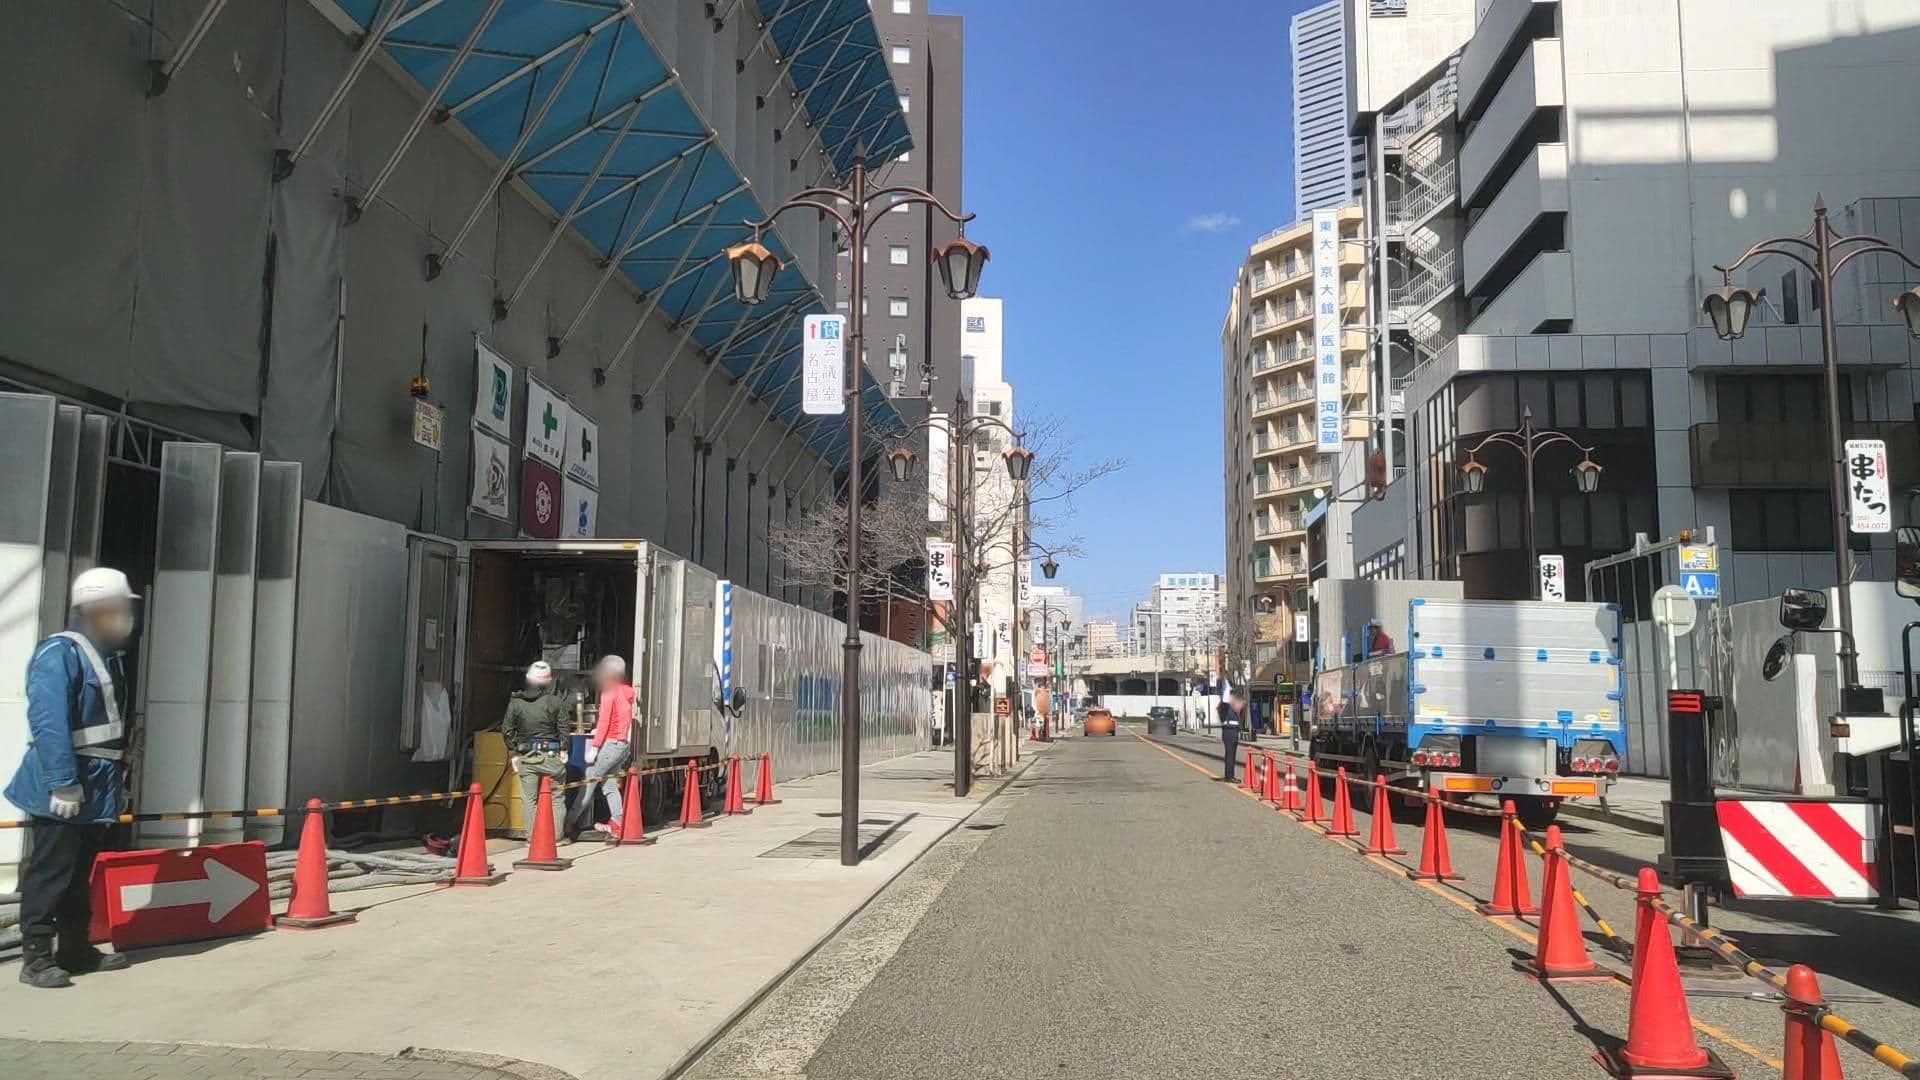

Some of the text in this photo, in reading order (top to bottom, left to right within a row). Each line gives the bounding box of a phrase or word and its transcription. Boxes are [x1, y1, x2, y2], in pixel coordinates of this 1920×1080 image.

[807, 353, 818, 401] 名古屋
[821, 320, 840, 401] 貸会議室
[1321, 401, 1339, 443] 河合塾
[1851, 453, 1886, 515] 串たつ
[930, 551, 950, 588] 串たつ
[1543, 563, 1562, 599] 串たつ
